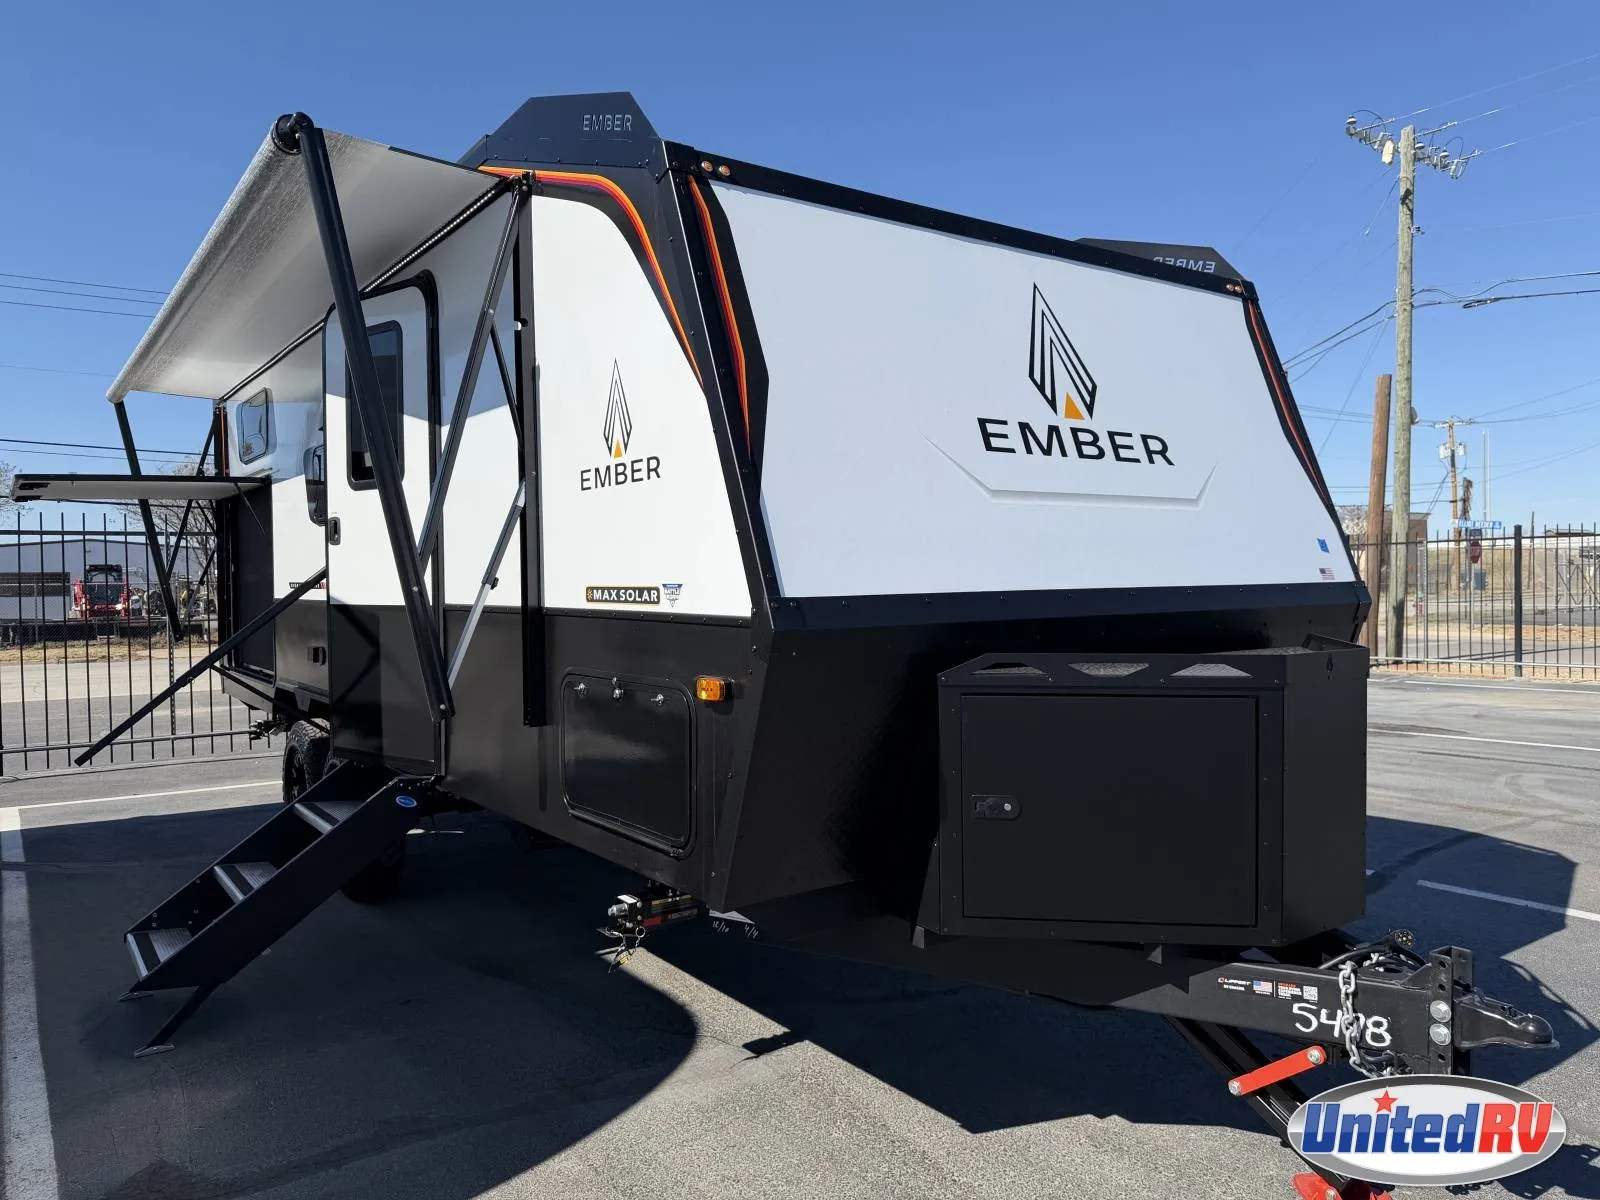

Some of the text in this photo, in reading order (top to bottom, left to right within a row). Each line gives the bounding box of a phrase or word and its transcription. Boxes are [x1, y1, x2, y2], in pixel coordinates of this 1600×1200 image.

[582, 114, 633, 132] EMBER
[977, 417, 1176, 466] EMBER
[580, 455, 661, 491] EMBER
[592, 588, 658, 602] MAX SOLAR
